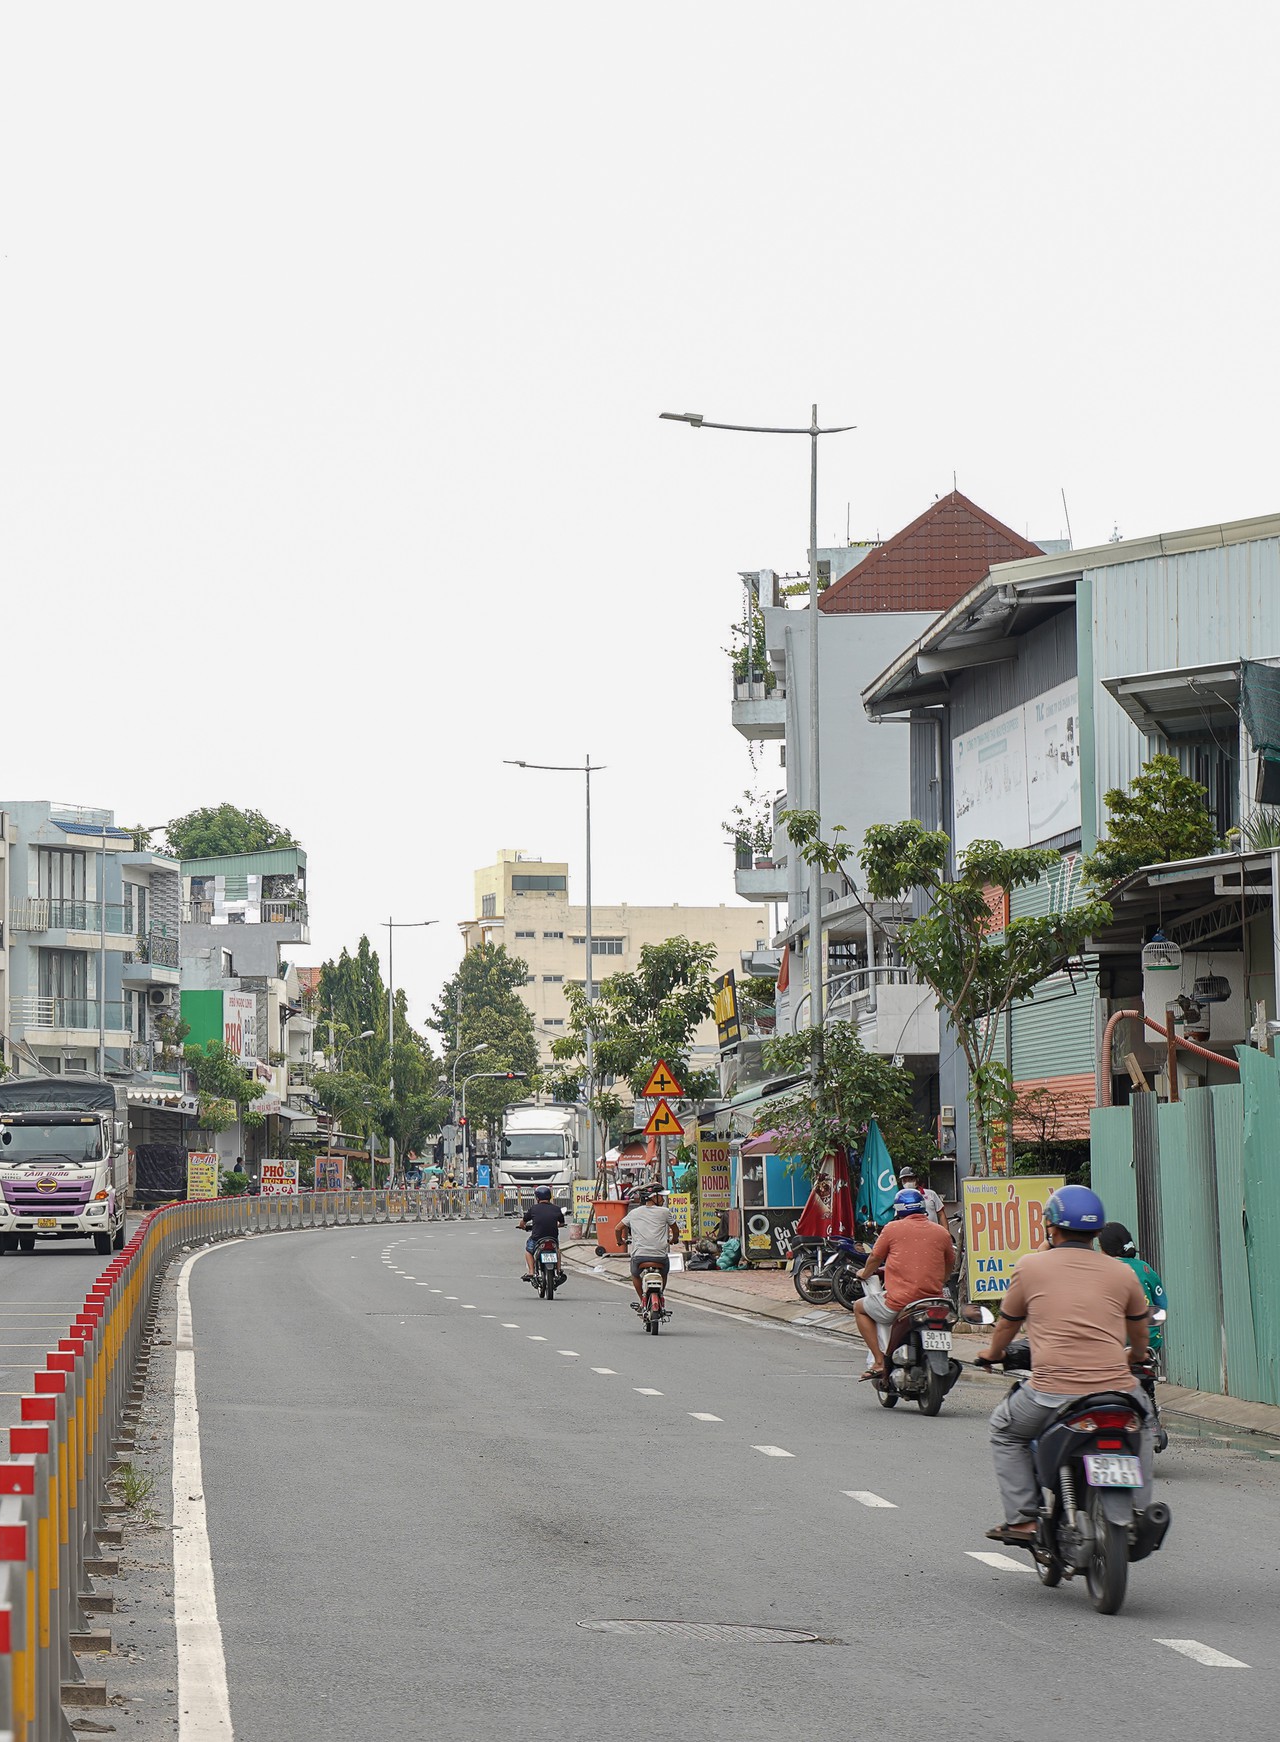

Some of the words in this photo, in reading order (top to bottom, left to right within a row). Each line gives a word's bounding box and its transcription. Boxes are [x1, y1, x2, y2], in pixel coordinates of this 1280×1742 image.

[263, 1161, 284, 1177] PHỞ
[701, 1175, 730, 1190] HONDA
[970, 1184, 1021, 1252] PHỞ
[773, 1226, 791, 1241] Cà
[976, 1256, 1003, 1273] TÁI
[975, 1276, 1011, 1292] GÂN
